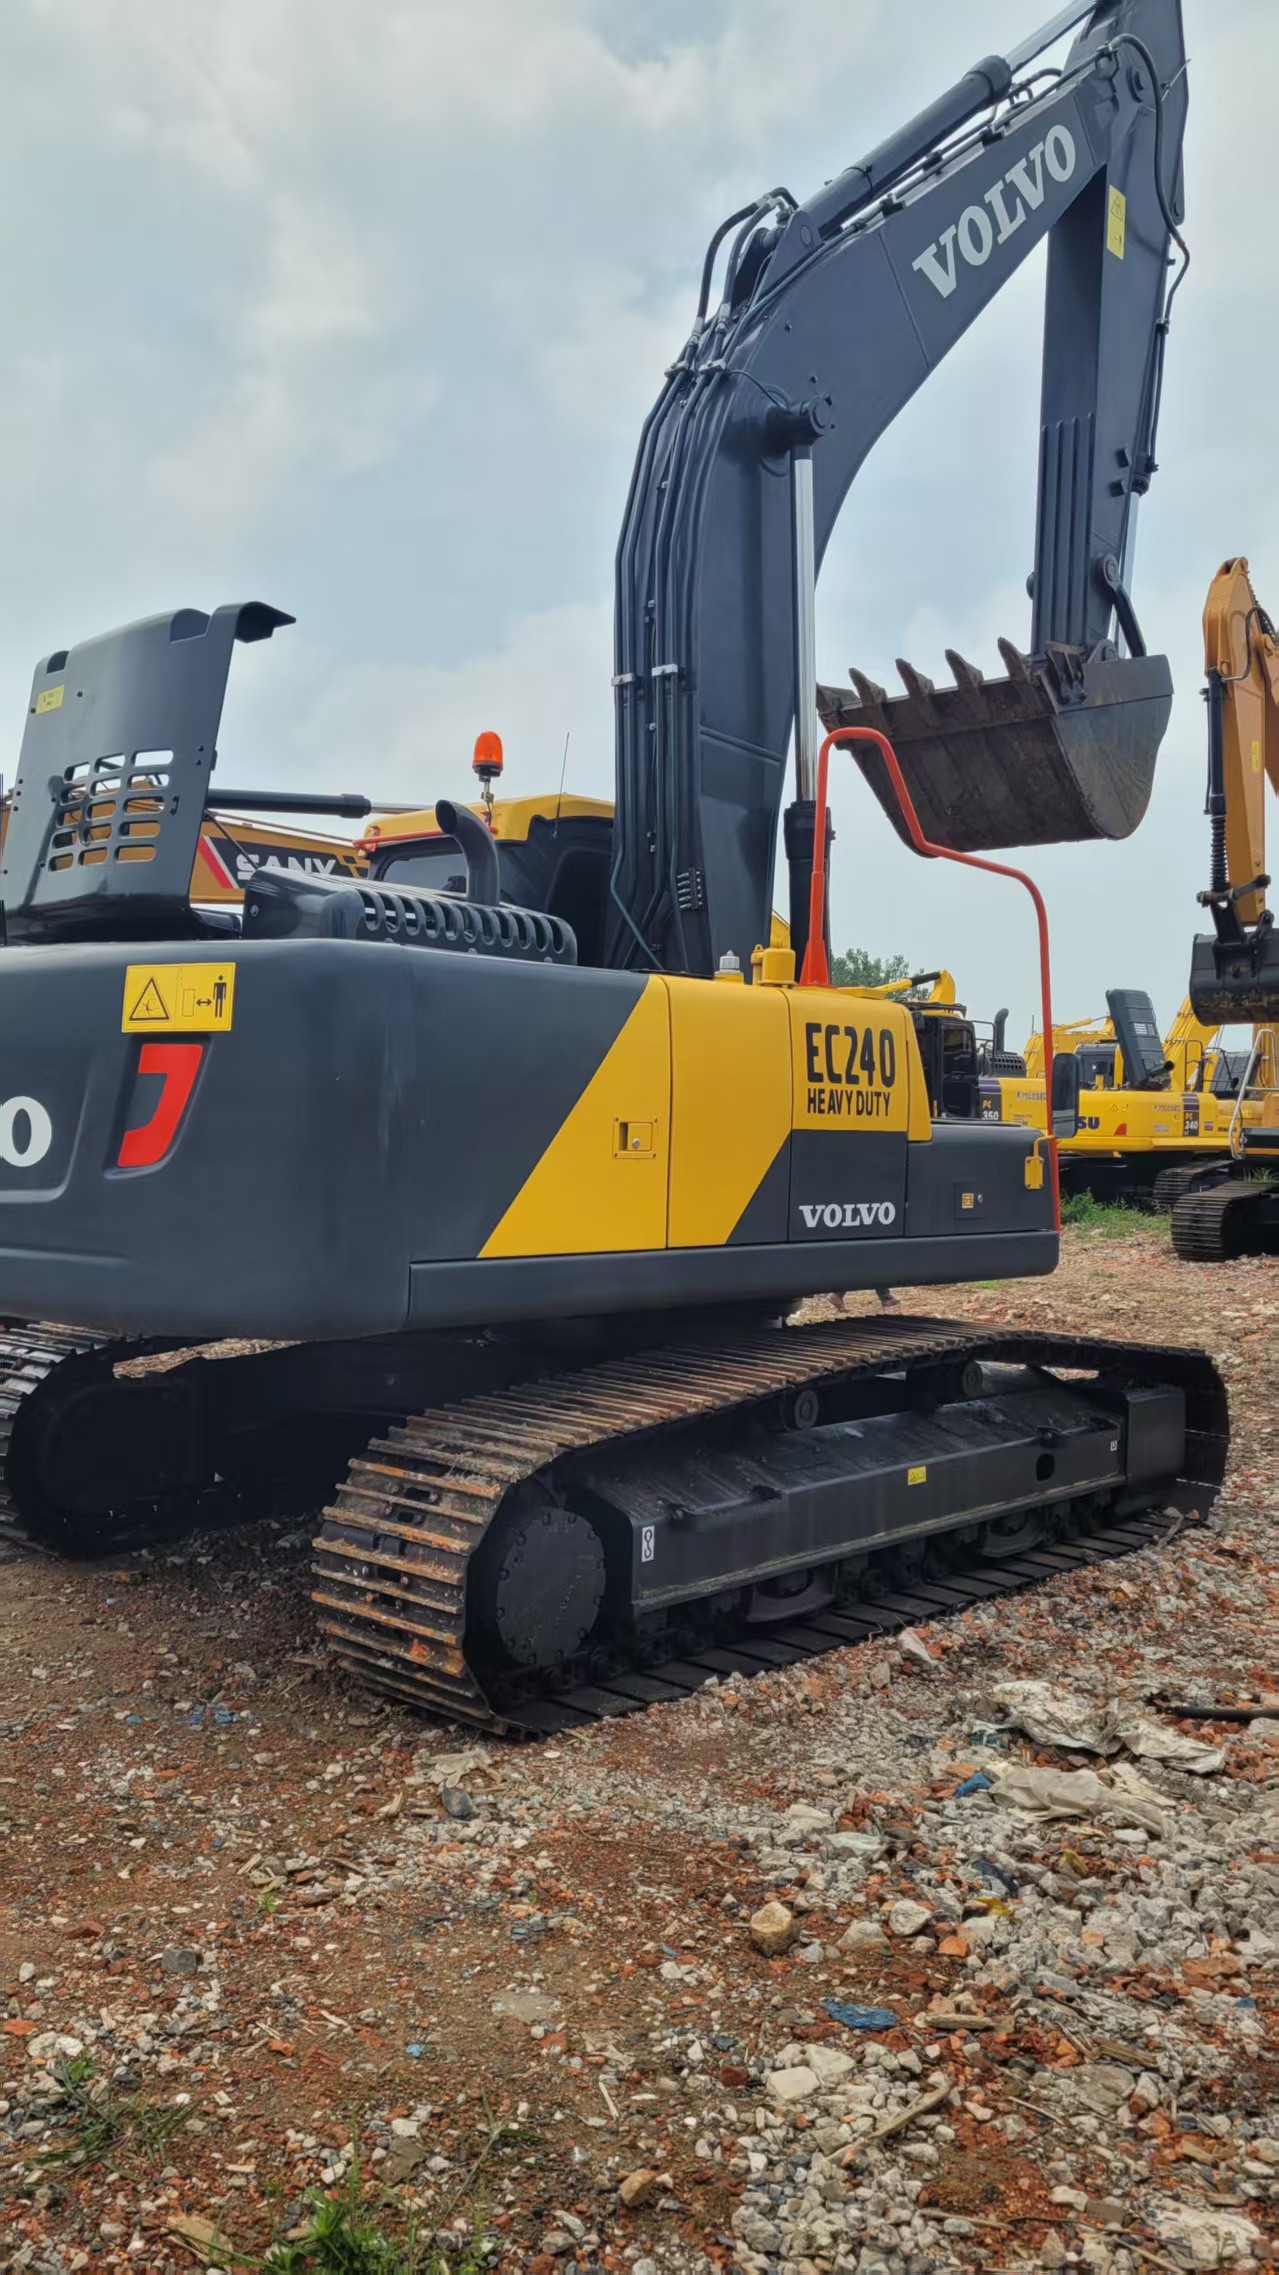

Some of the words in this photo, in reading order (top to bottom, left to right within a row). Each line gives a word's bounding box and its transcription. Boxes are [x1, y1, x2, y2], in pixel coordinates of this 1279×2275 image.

[912, 125, 1076, 298] VOLVO
[805, 1022, 896, 1088] EC240
[807, 1088, 853, 1116] HEAVY
[856, 1090, 891, 1117] DUTY
[982, 1110, 999, 1120] 350
[1185, 1120, 1198, 1130] 240
[799, 1202, 896, 1228] VOLVO
